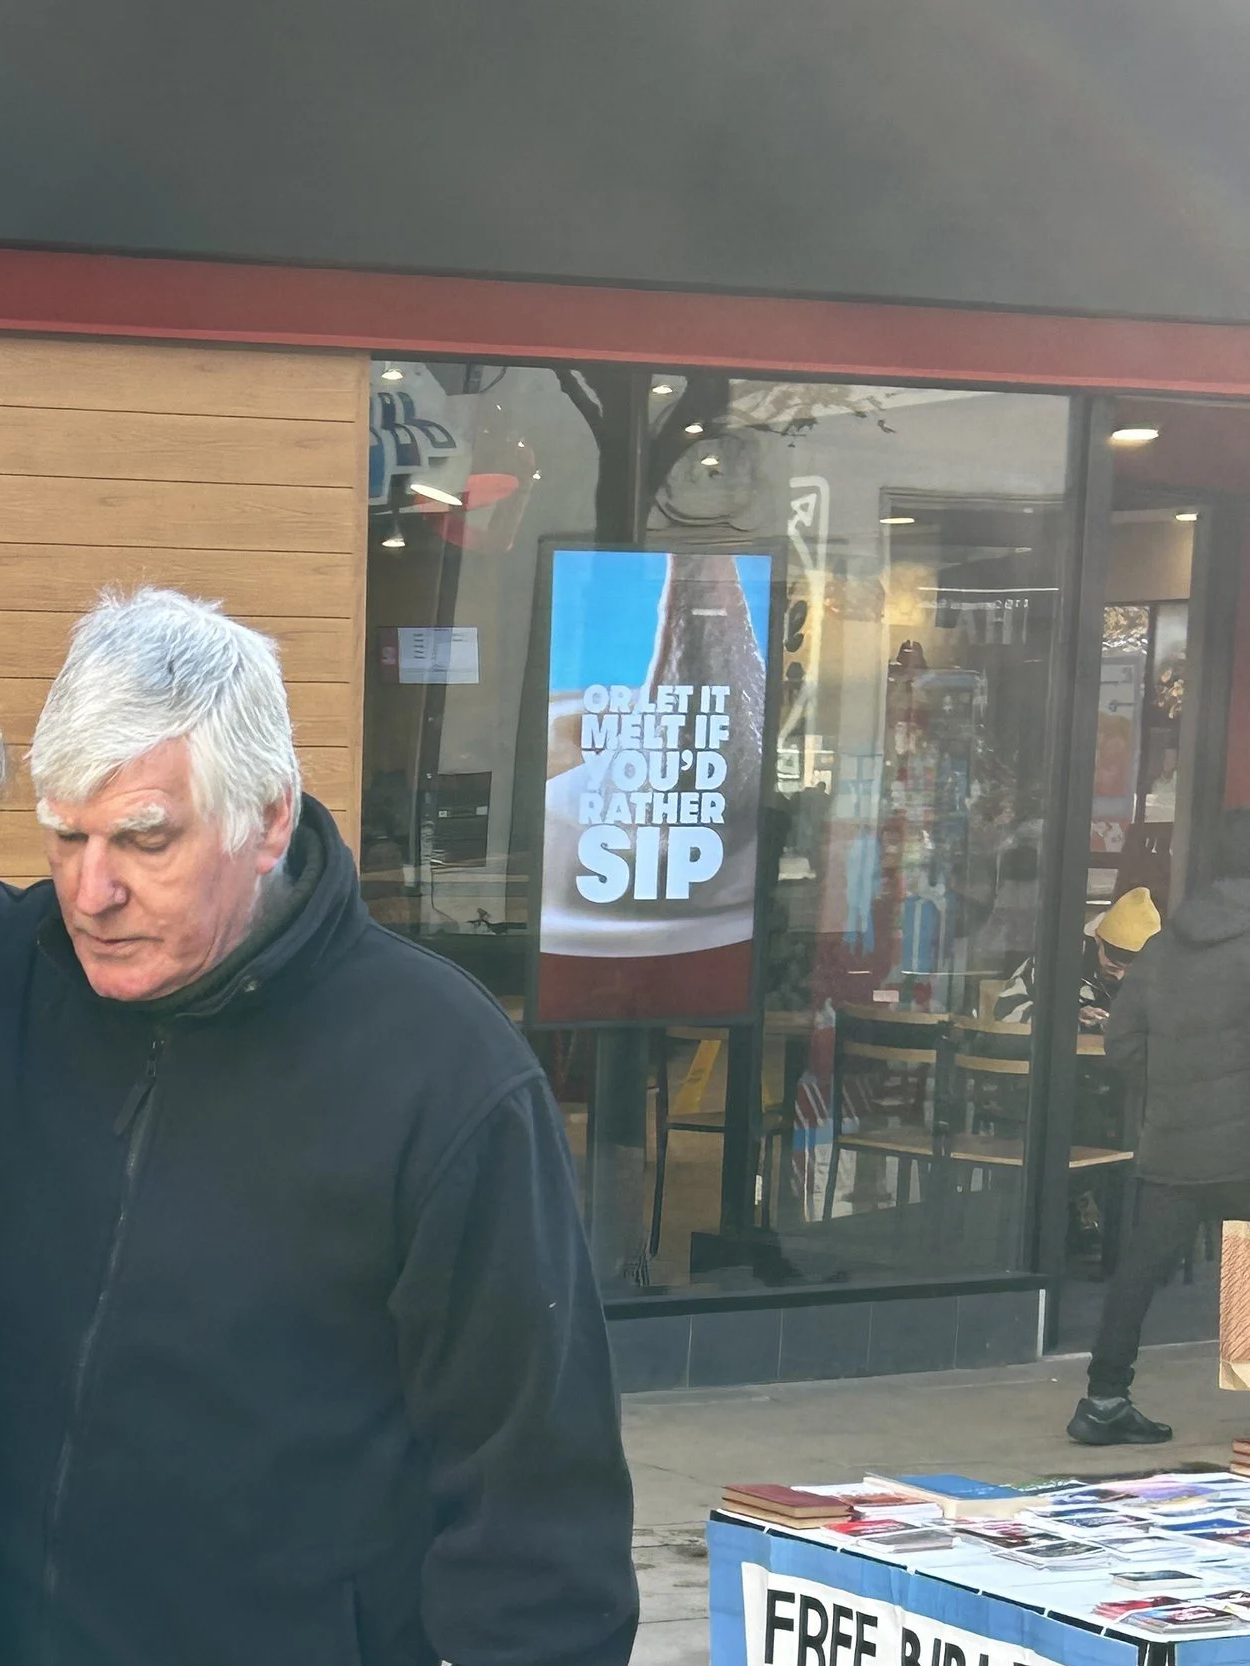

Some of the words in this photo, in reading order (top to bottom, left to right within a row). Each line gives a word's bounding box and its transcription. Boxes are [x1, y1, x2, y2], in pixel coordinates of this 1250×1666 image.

[582, 684, 633, 713] OR
[637, 685, 694, 713] LET
[700, 685, 731, 713] IT
[581, 714, 686, 749] MELT
[695, 714, 730, 750] IF
[581, 749, 727, 791] YOU'D
[579, 791, 726, 825] RATHER
[576, 823, 724, 904] SIP
